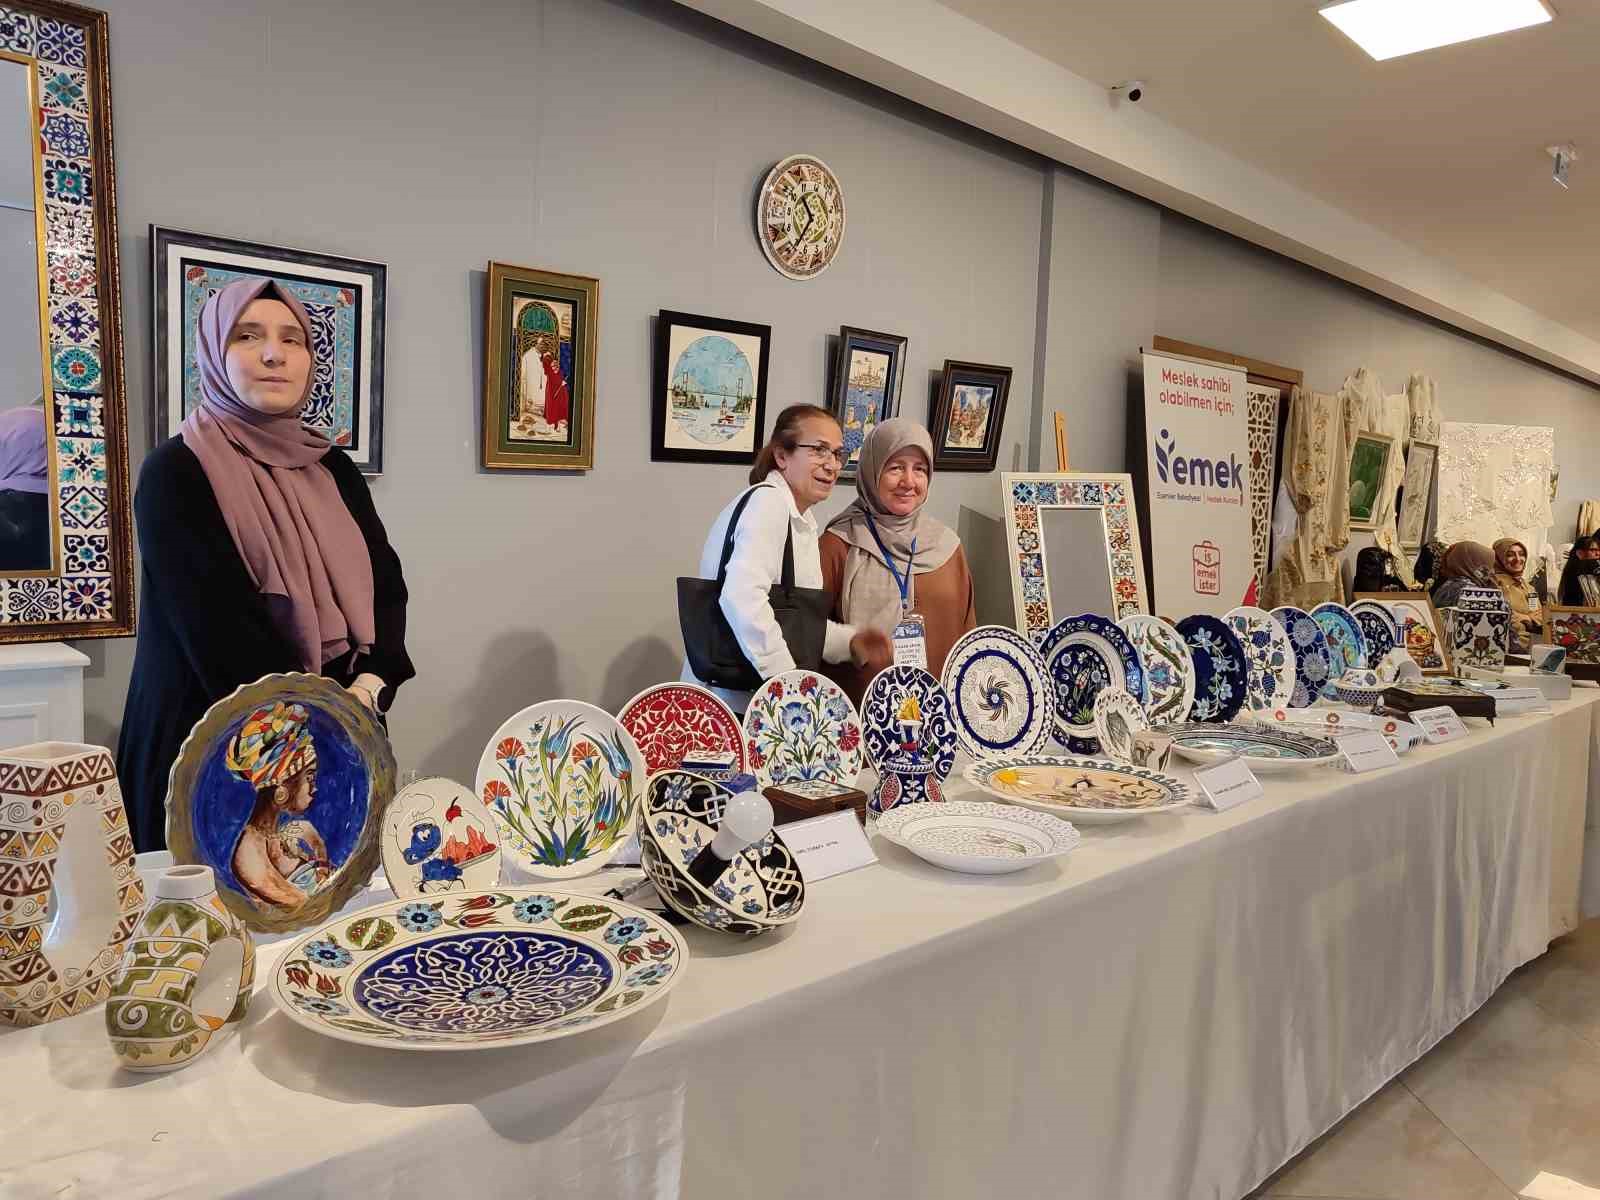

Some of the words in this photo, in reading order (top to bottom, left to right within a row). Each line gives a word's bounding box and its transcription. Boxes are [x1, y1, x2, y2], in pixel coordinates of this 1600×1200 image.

[1162, 368, 1199, 389] Meslek
[1201, 375, 1232, 394] sahibi
[1160, 389, 1212, 411] olabilmen
[1173, 453, 1243, 507] emek
